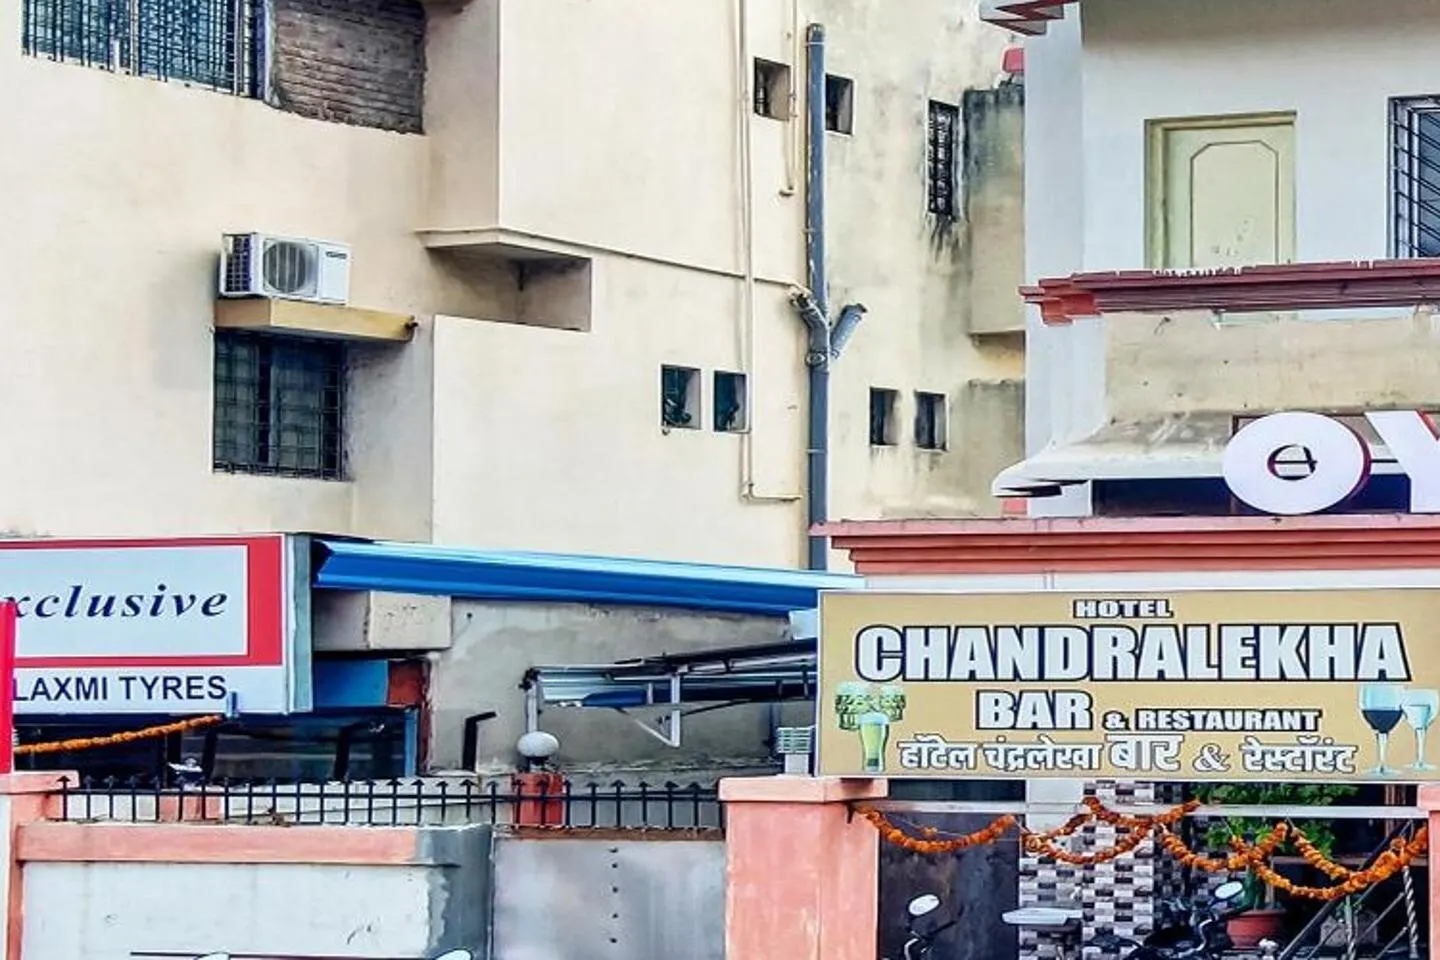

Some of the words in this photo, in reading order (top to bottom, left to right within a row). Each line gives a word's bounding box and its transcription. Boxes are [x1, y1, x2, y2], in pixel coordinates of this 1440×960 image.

[1073, 599, 1174, 619] HOTEL
[856, 624, 1410, 681] CHANDRALEKHA
[119, 675, 227, 700] TYRES
[976, 690, 1094, 730] BAR
[1104, 711, 1130, 730] &
[1136, 709, 1320, 732] RESTAURANT
[1106, 734, 1183, 771] बार
[1193, 744, 1230, 772] &
